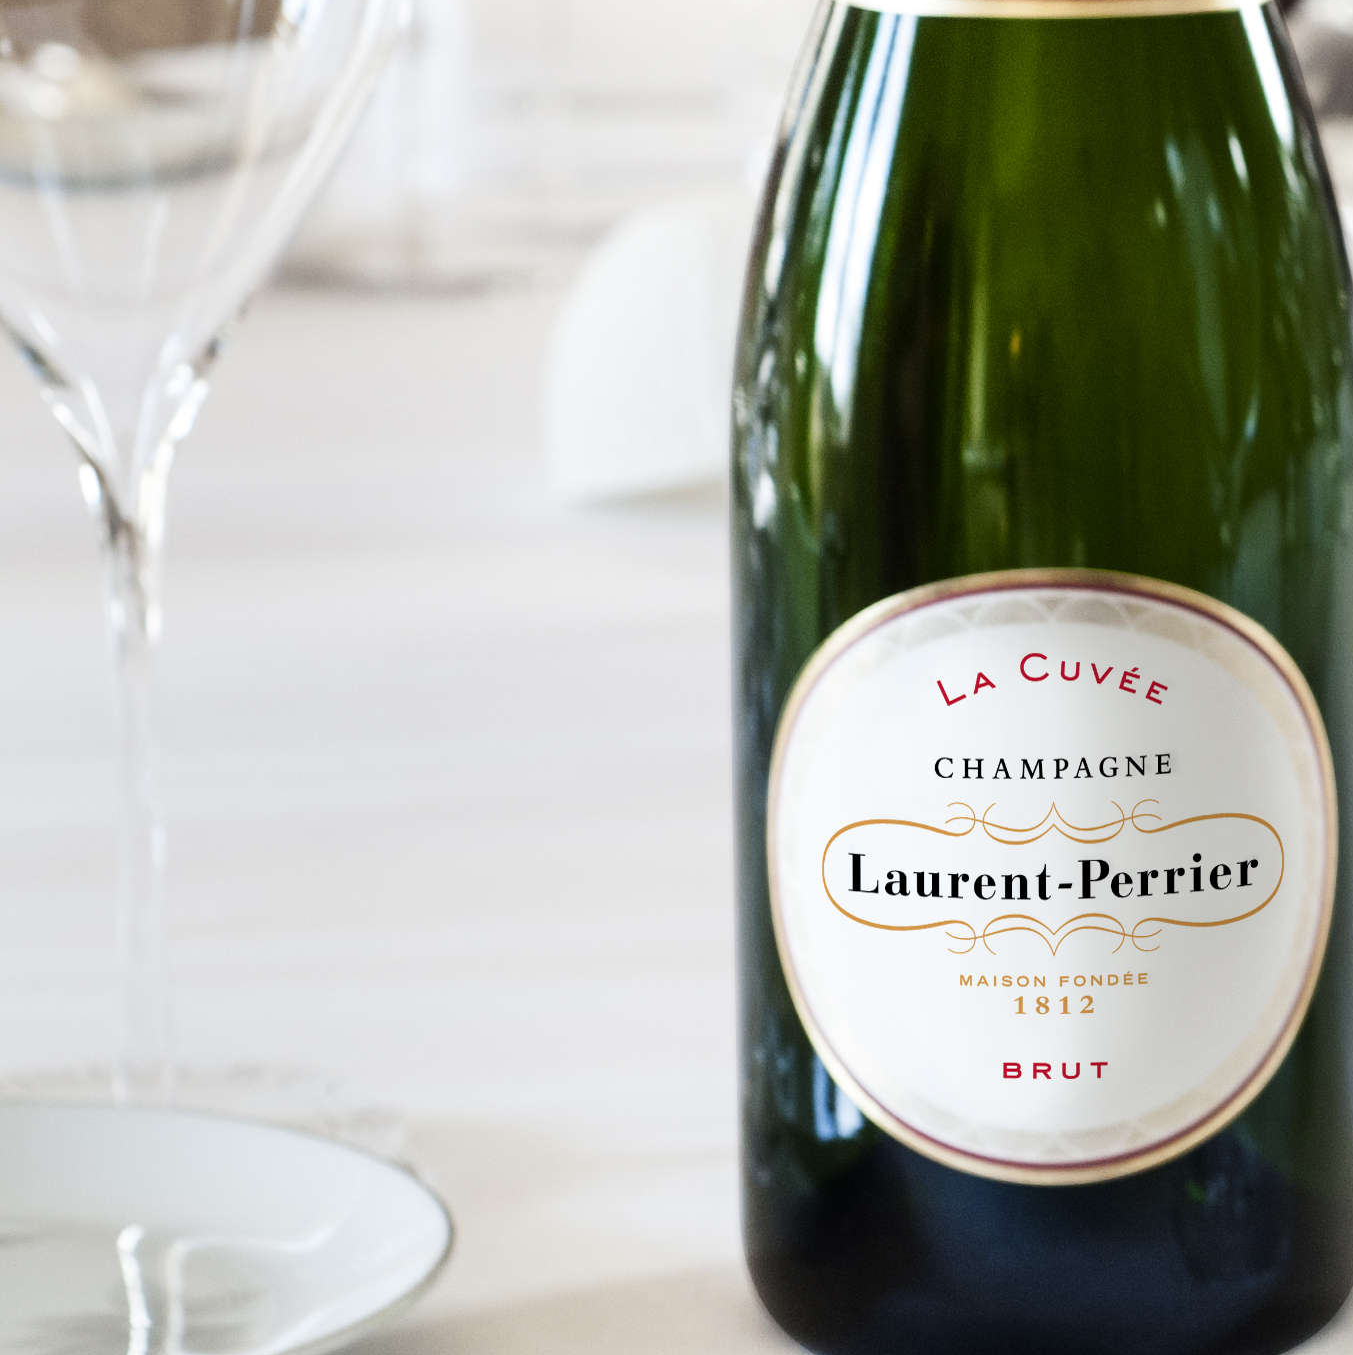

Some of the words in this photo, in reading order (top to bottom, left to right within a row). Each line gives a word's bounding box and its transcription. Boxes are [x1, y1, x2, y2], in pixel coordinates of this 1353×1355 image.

[933, 752, 1173, 781] CHAMPAGNE
[847, 851, 1259, 901] Laurent-Perrier
[958, 973, 1047, 989] MAISON
[1058, 970, 1150, 989] FONDÉE
[1013, 994, 1096, 1016] 1812
[1002, 1061, 1109, 1081] BRUT
